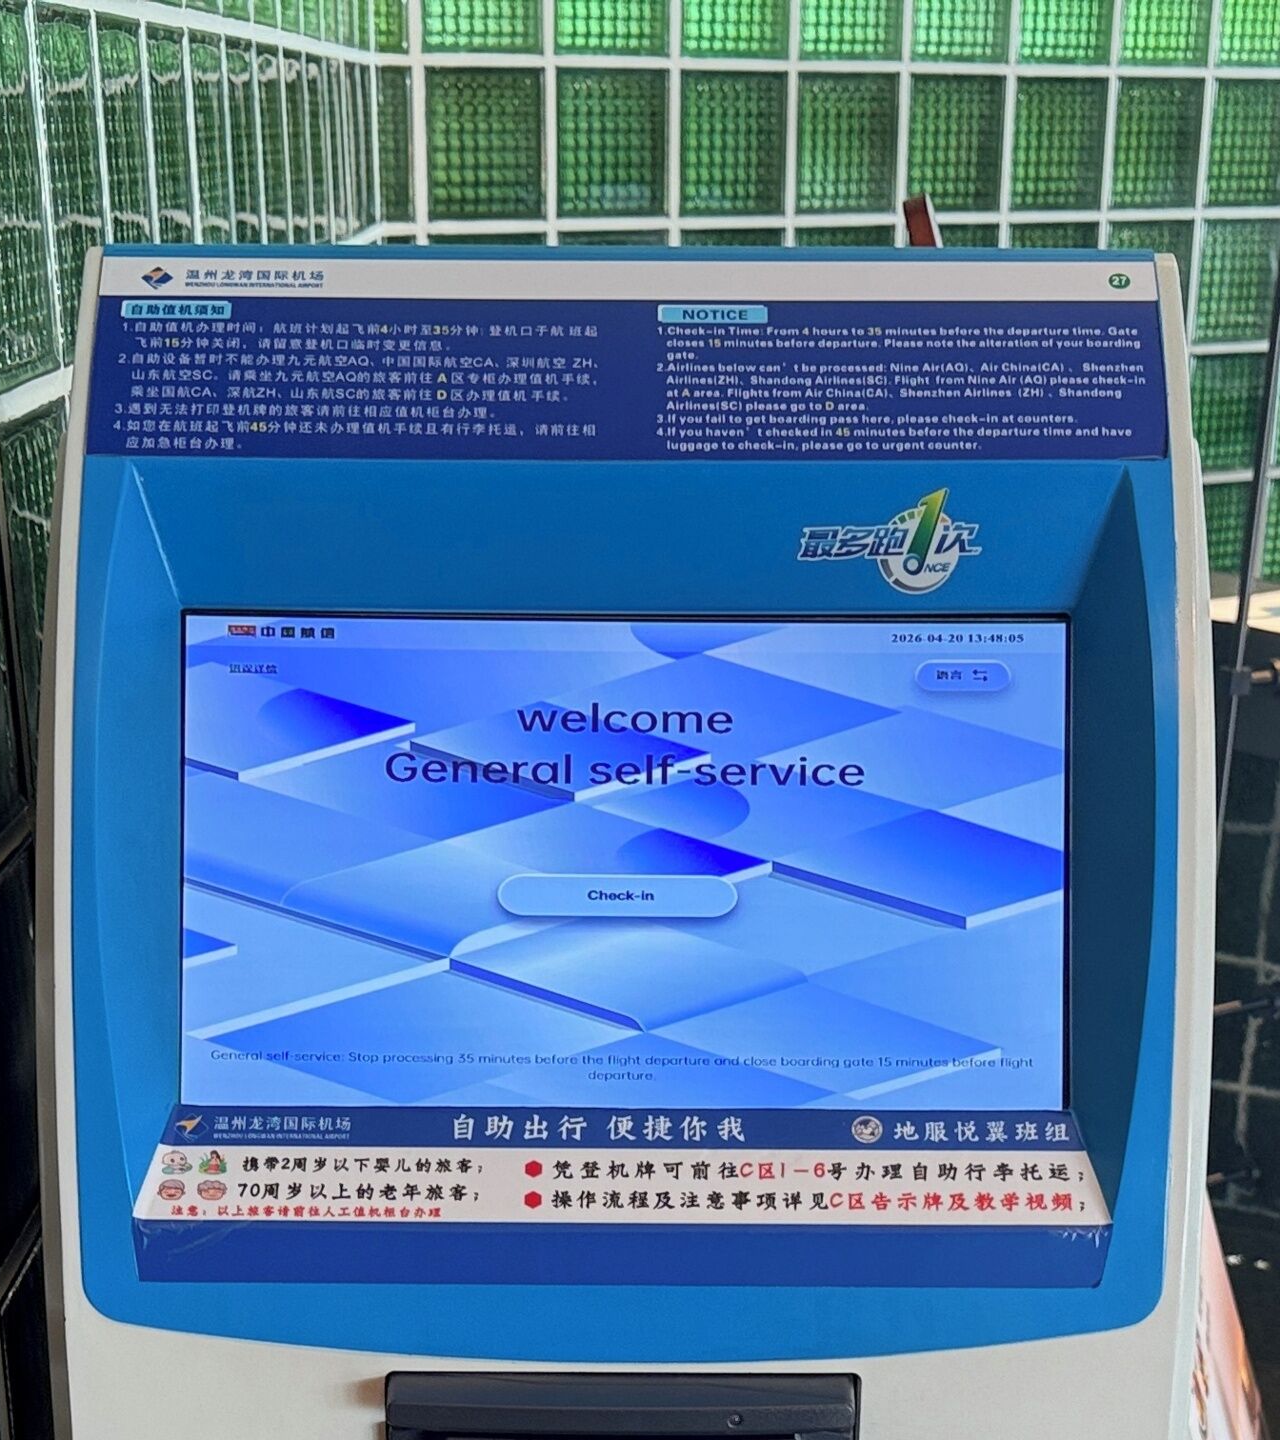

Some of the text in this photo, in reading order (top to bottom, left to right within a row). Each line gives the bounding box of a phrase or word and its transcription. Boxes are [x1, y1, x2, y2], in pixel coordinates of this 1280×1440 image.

[186, 268, 325, 281] 温州龙湾国际机场
[1111, 275, 1128, 287] 27
[131, 304, 226, 316] 自助值机须知
[682, 309, 748, 321] NOTICE
[890, 633, 1025, 645] 2026-04-20 13:48:05
[517, 702, 734, 735] welcome
[385, 752, 866, 786] General self-service
[586, 888, 656, 903] Check-in
[210, 1049, 263, 1061] General
[347, 1050, 380, 1065] Stop
[381, 1050, 455, 1065] processing
[456, 1050, 476, 1062] 35
[477, 1052, 532, 1063] minutes
[534, 1051, 579, 1063] before
[581, 1051, 605, 1063] the
[606, 1051, 642, 1066] flight
[643, 1052, 711, 1067] departure
[712, 1052, 741, 1064] and
[742, 1052, 778, 1064] close
[779, 1052, 840, 1067] boarding
[842, 1053, 875, 1068] gate
[877, 1053, 894, 1066] 15
[894, 1054, 950, 1066] minutes
[951, 1054, 998, 1067] before
[998, 1054, 1035, 1070] flight
[213, 1115, 352, 1132] 温州龙湾国际机场
[452, 1114, 748, 1144] 自助出行 便捷你我
[892, 1120, 1070, 1143] 地服悦翼班组
